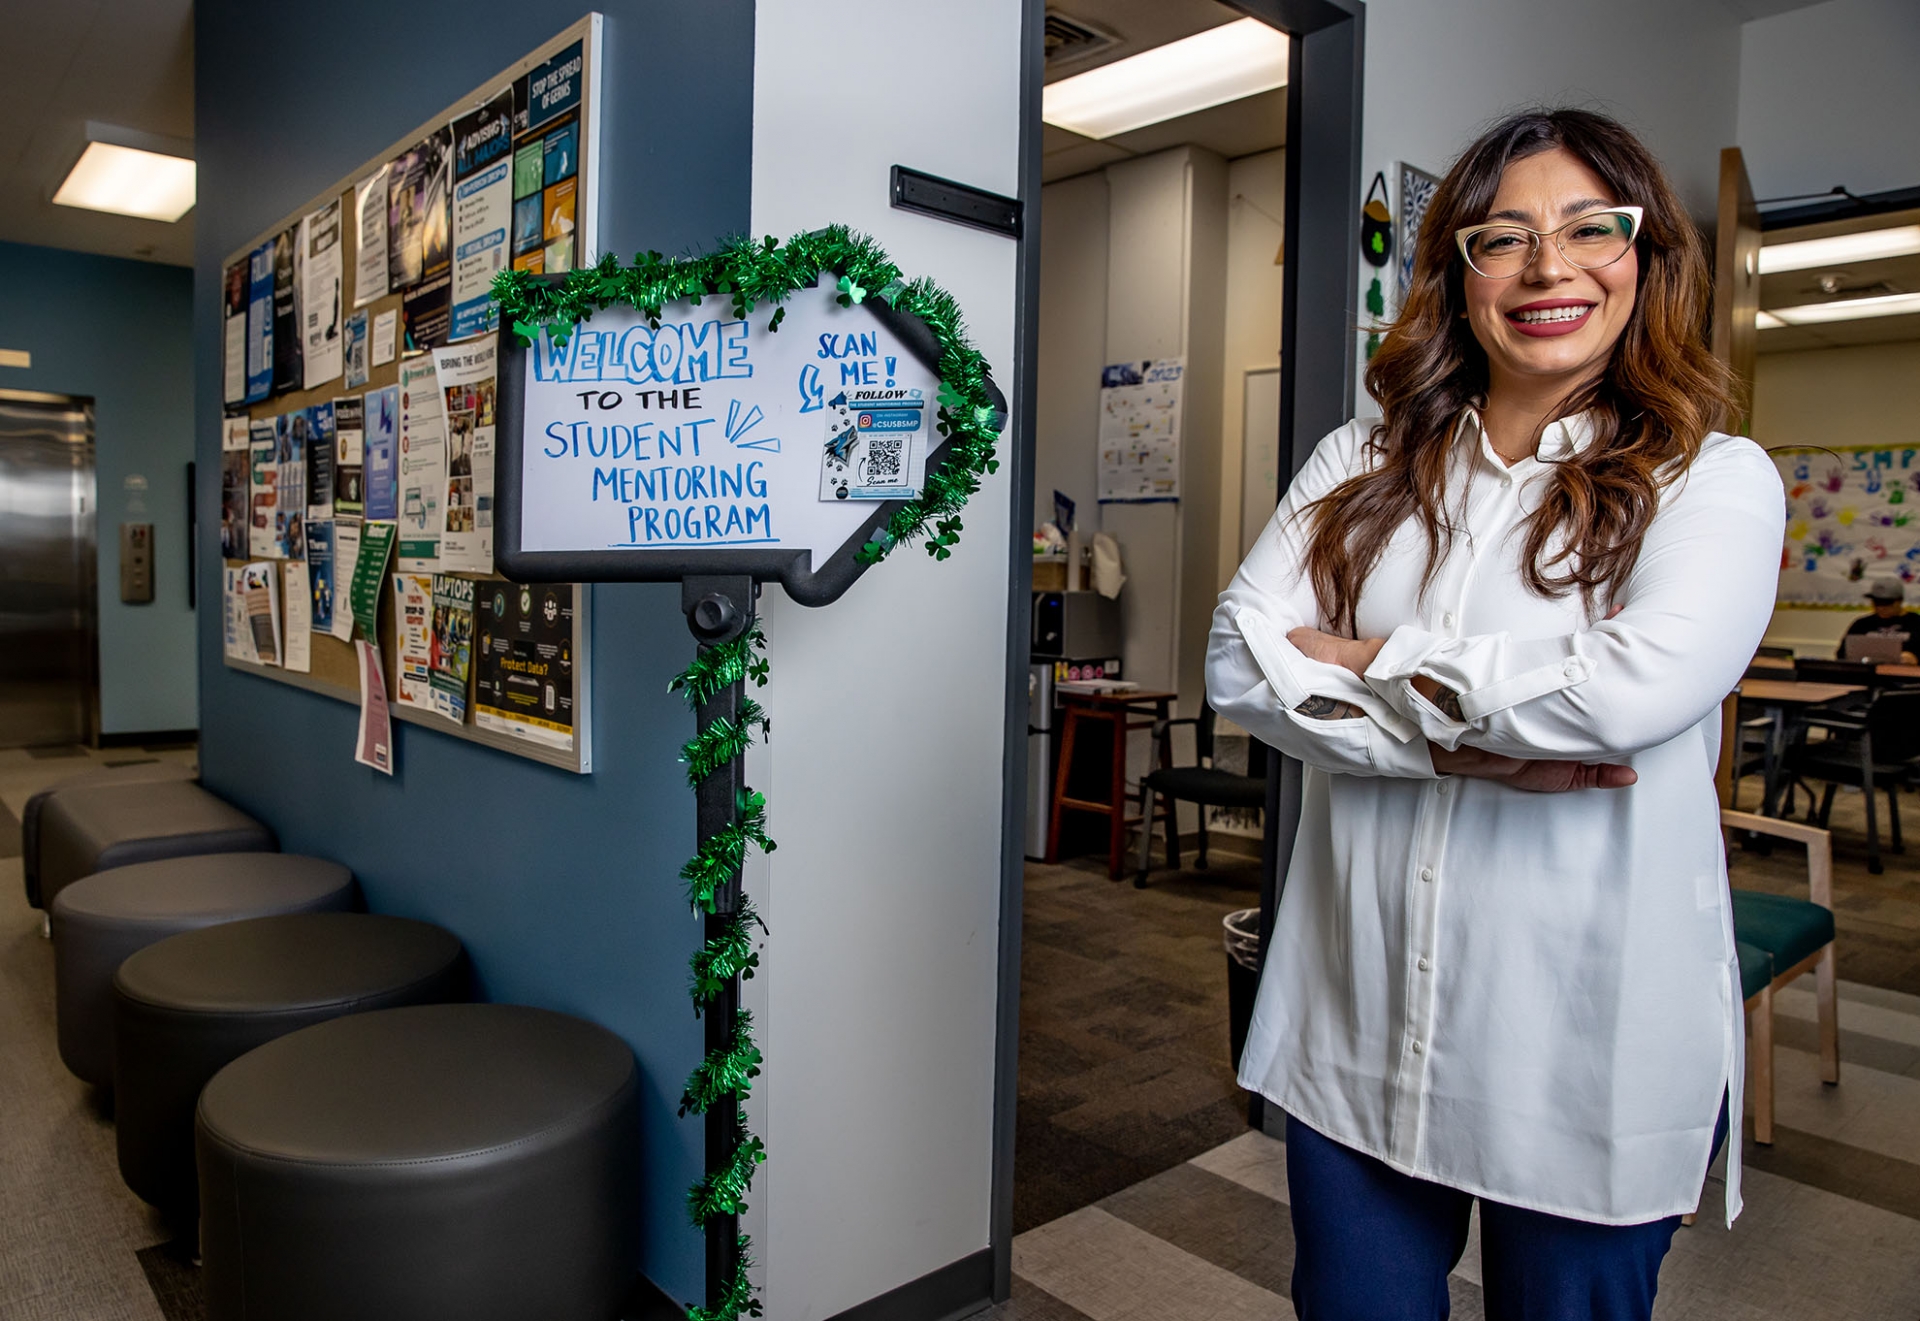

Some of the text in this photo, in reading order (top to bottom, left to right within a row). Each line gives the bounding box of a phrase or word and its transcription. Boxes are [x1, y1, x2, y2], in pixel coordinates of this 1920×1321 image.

[533, 320, 754, 385] WELCOME
[817, 331, 877, 359] SCAN
[840, 357, 897, 388] ME!
[576, 387, 703, 410] TO THE
[855, 390, 907, 400] FOLLOW
[872, 420, 919, 429] @CSUSBSMP
[544, 418, 716, 461] STUDENT
[593, 460, 768, 503] MENTORING
[866, 476, 886, 486] Scan
[628, 503, 772, 543] PROGRAM
[434, 574, 474, 601] LAPTOPS
[500, 657, 549, 676] Protect Data?
